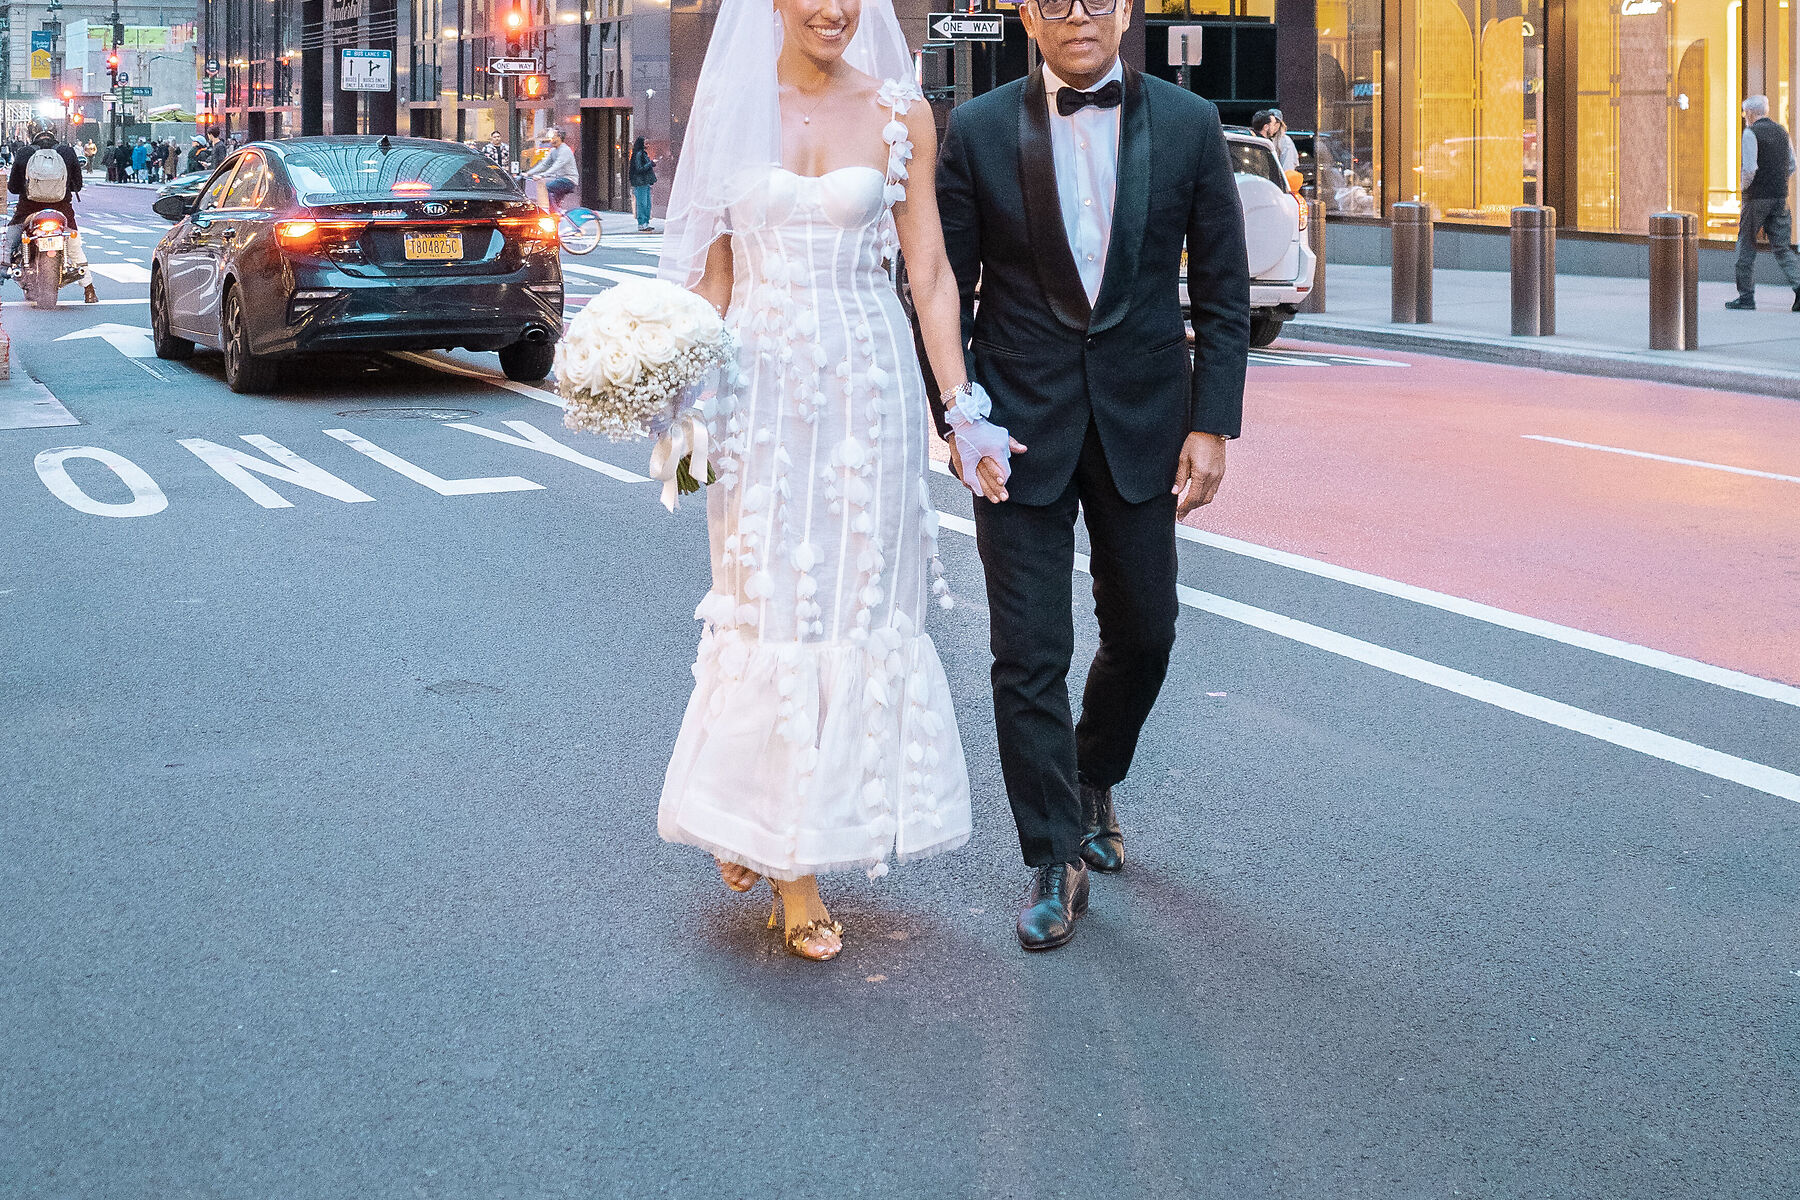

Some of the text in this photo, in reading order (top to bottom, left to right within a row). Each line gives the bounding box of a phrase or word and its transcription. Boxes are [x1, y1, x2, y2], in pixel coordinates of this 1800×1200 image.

[943, 22, 995, 32] ONE WAY
[372, 209, 402, 217] BUGGY
[426, 204, 444, 214] KIA
[410, 240, 457, 254] T804825C
[33, 419, 656, 518] ONLY
